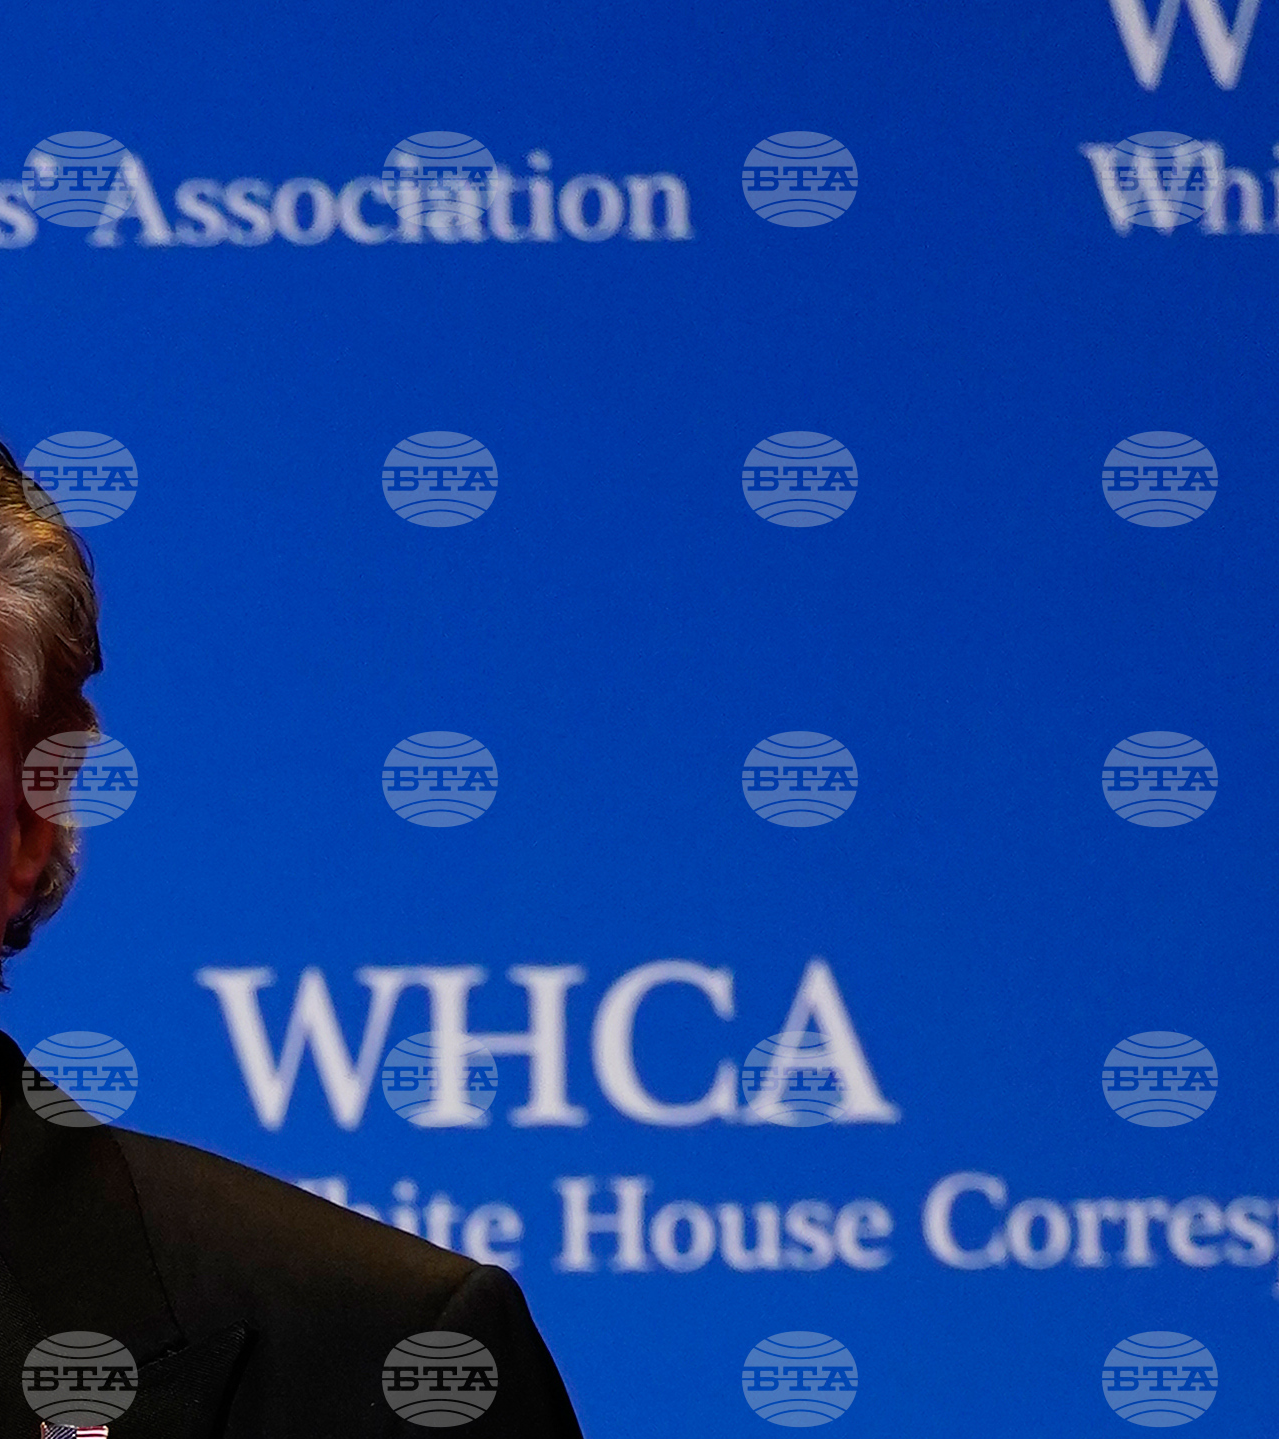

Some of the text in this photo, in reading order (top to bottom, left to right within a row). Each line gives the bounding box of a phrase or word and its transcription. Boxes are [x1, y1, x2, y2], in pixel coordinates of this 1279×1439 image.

[86, 150, 693, 249] Association
[1079, 140, 1279, 238] Wh
[196, 958, 899, 1132] WHCA
[554, 1174, 895, 1273] House
[921, 1170, 1279, 1302] Corres
